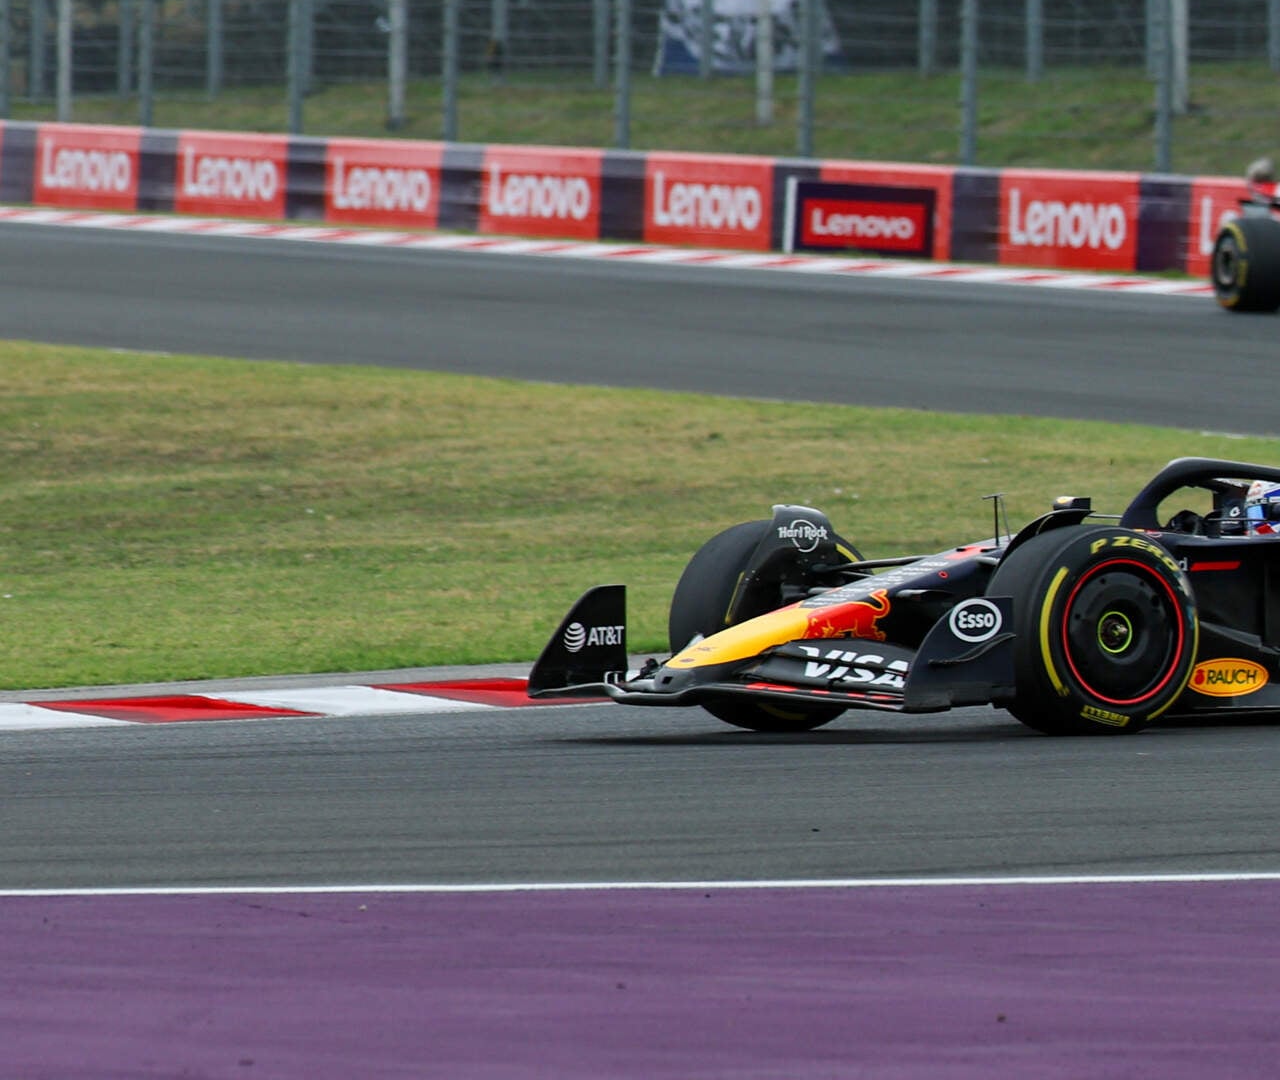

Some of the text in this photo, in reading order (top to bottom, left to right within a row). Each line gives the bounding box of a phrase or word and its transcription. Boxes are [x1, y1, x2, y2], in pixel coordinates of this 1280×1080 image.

[41, 137, 130, 193] Lenovo
[183, 146, 278, 201] Lenovo
[333, 156, 431, 212] Lenovo
[488, 163, 591, 220] Lenovo
[653, 172, 763, 230] Lenovo
[811, 208, 916, 239] Lenovo
[1009, 188, 1128, 250] Lenovo
[778, 526, 828, 540] Hard Rock
[1090, 537, 1108, 554] P
[1111, 535, 1180, 572] ZERO
[587, 625, 625, 646] AT&T
[957, 610, 995, 629] Esso
[799, 645, 910, 688] VISA
[1206, 669, 1258, 685] RAUCH
